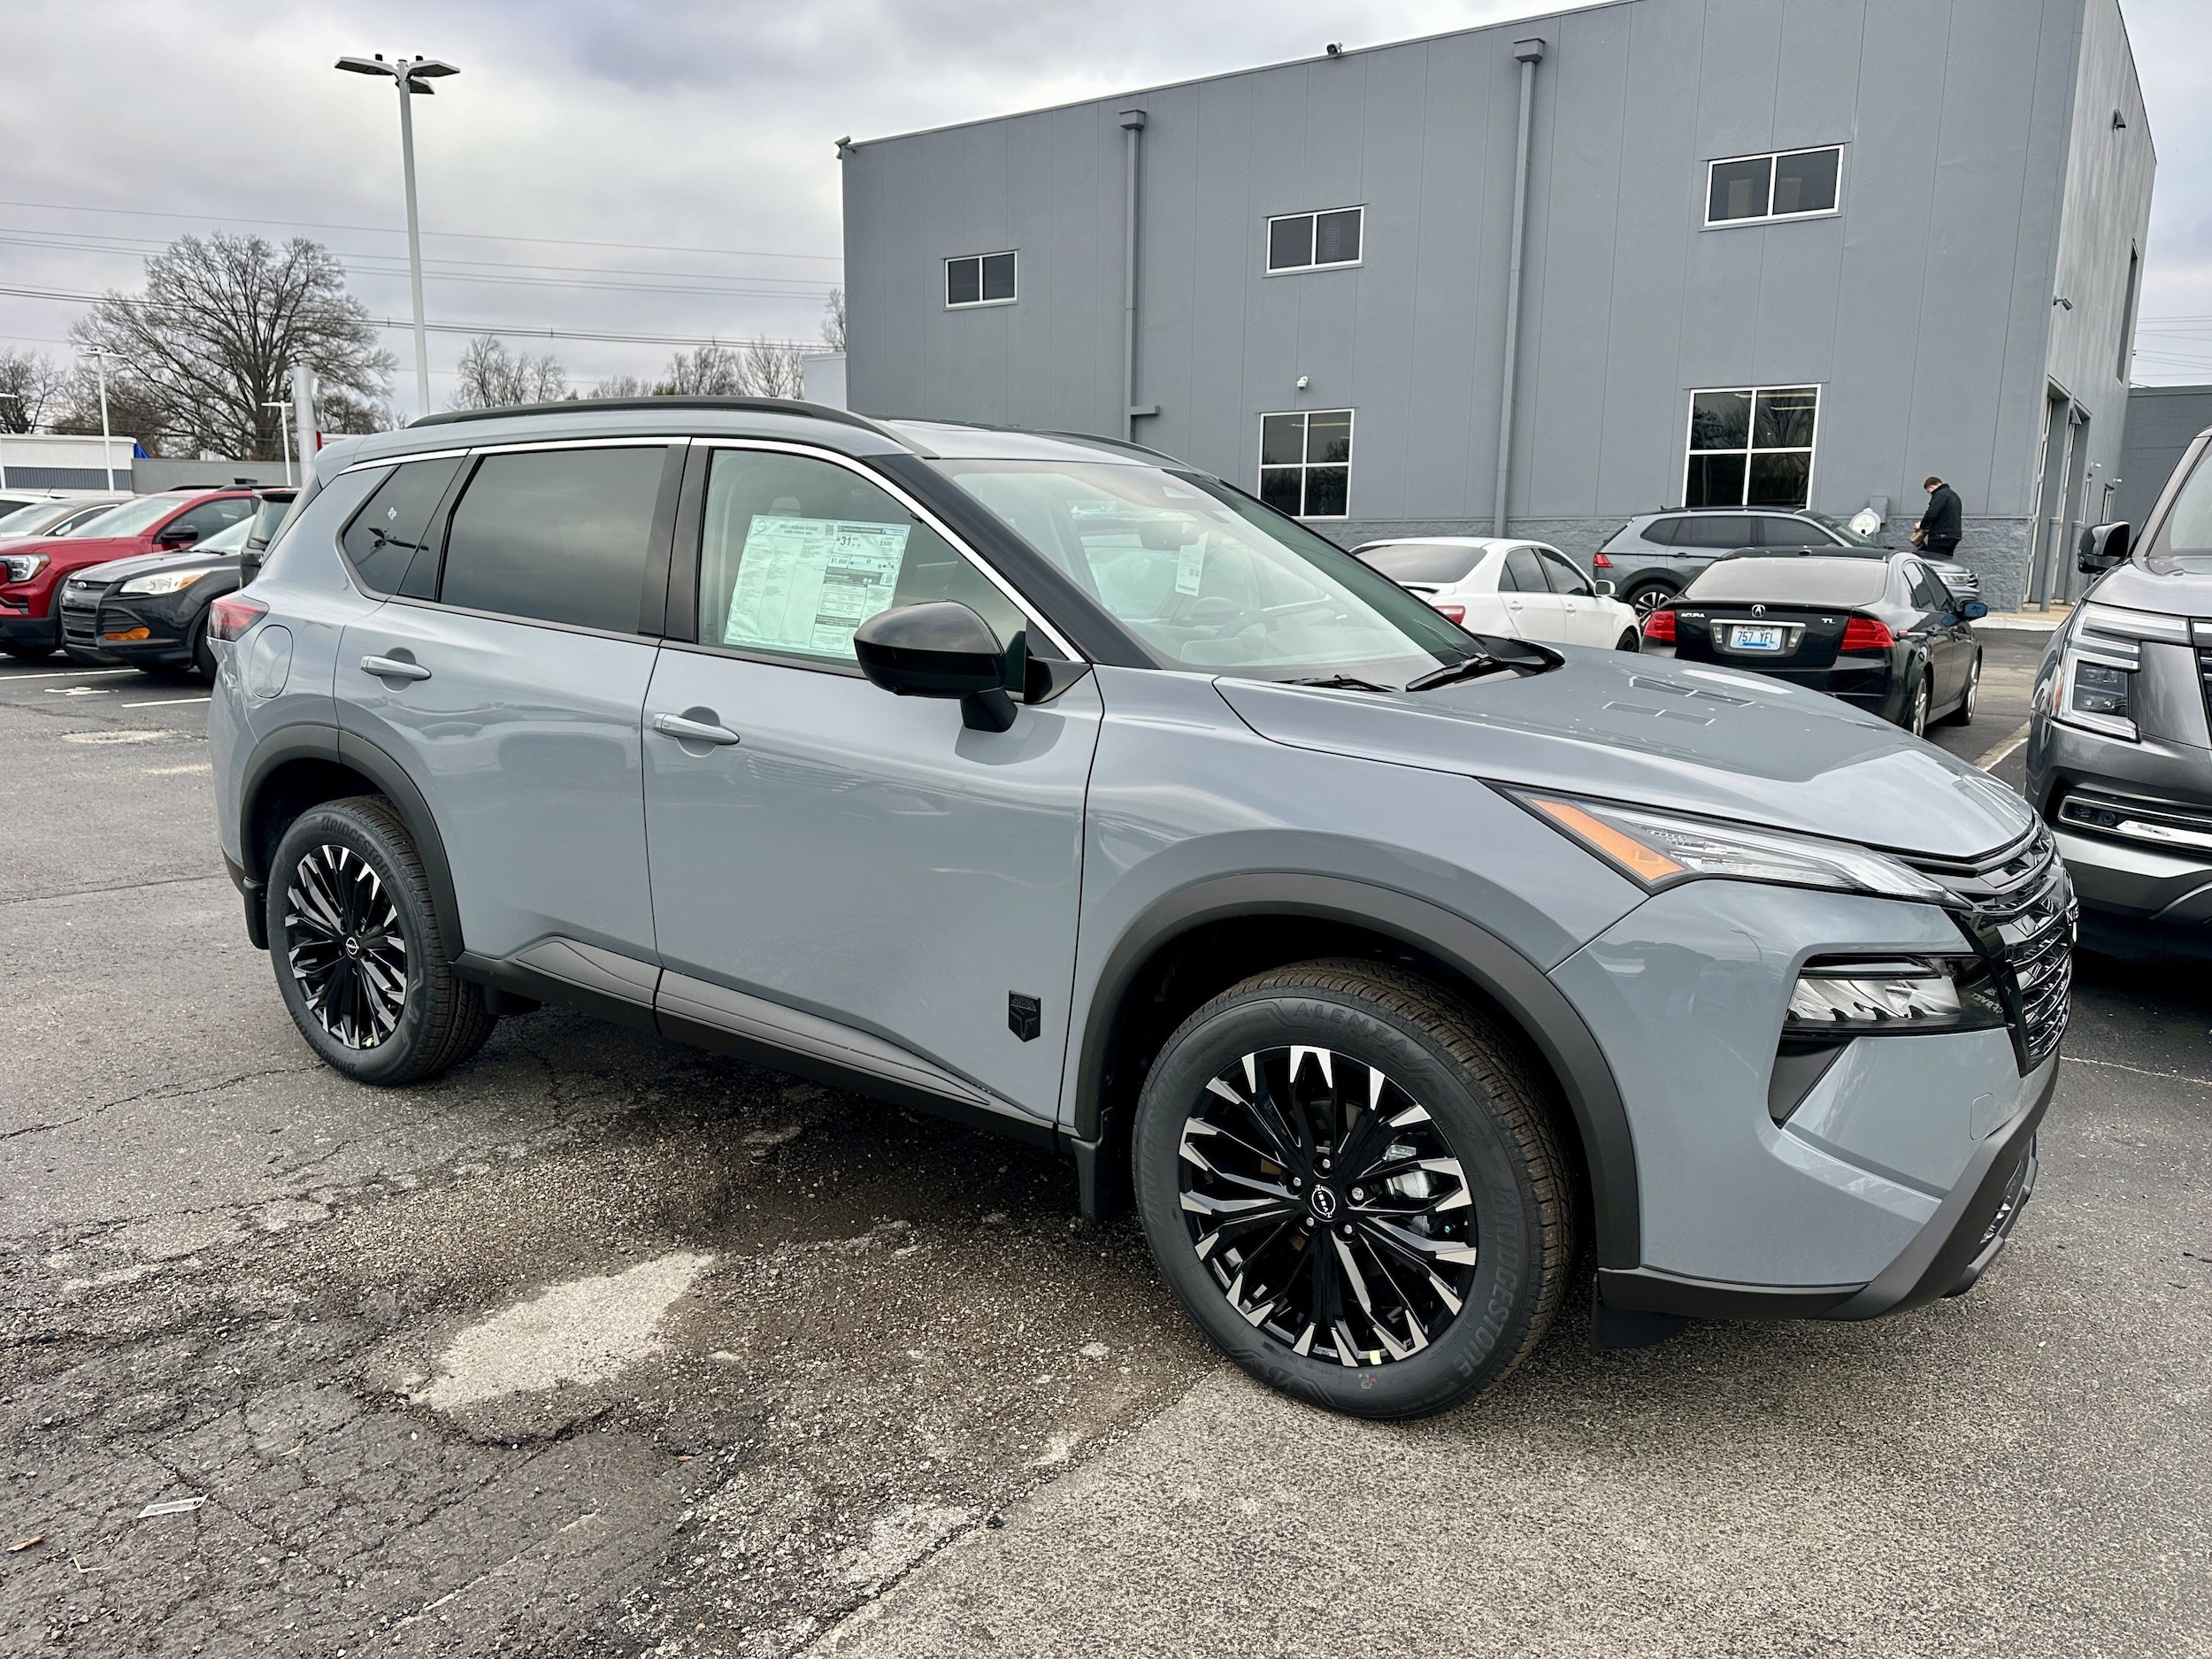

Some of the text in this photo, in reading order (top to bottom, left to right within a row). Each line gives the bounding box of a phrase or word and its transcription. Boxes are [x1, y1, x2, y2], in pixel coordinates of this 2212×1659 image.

[840, 536, 851, 546] 31
[1738, 631, 1775, 644] 757 YFL
[321, 817, 396, 885] BRIDGESTONE
[1294, 1002, 1409, 1057] ALENZA
[1453, 1189, 1521, 1379] BRIDGESTONE
